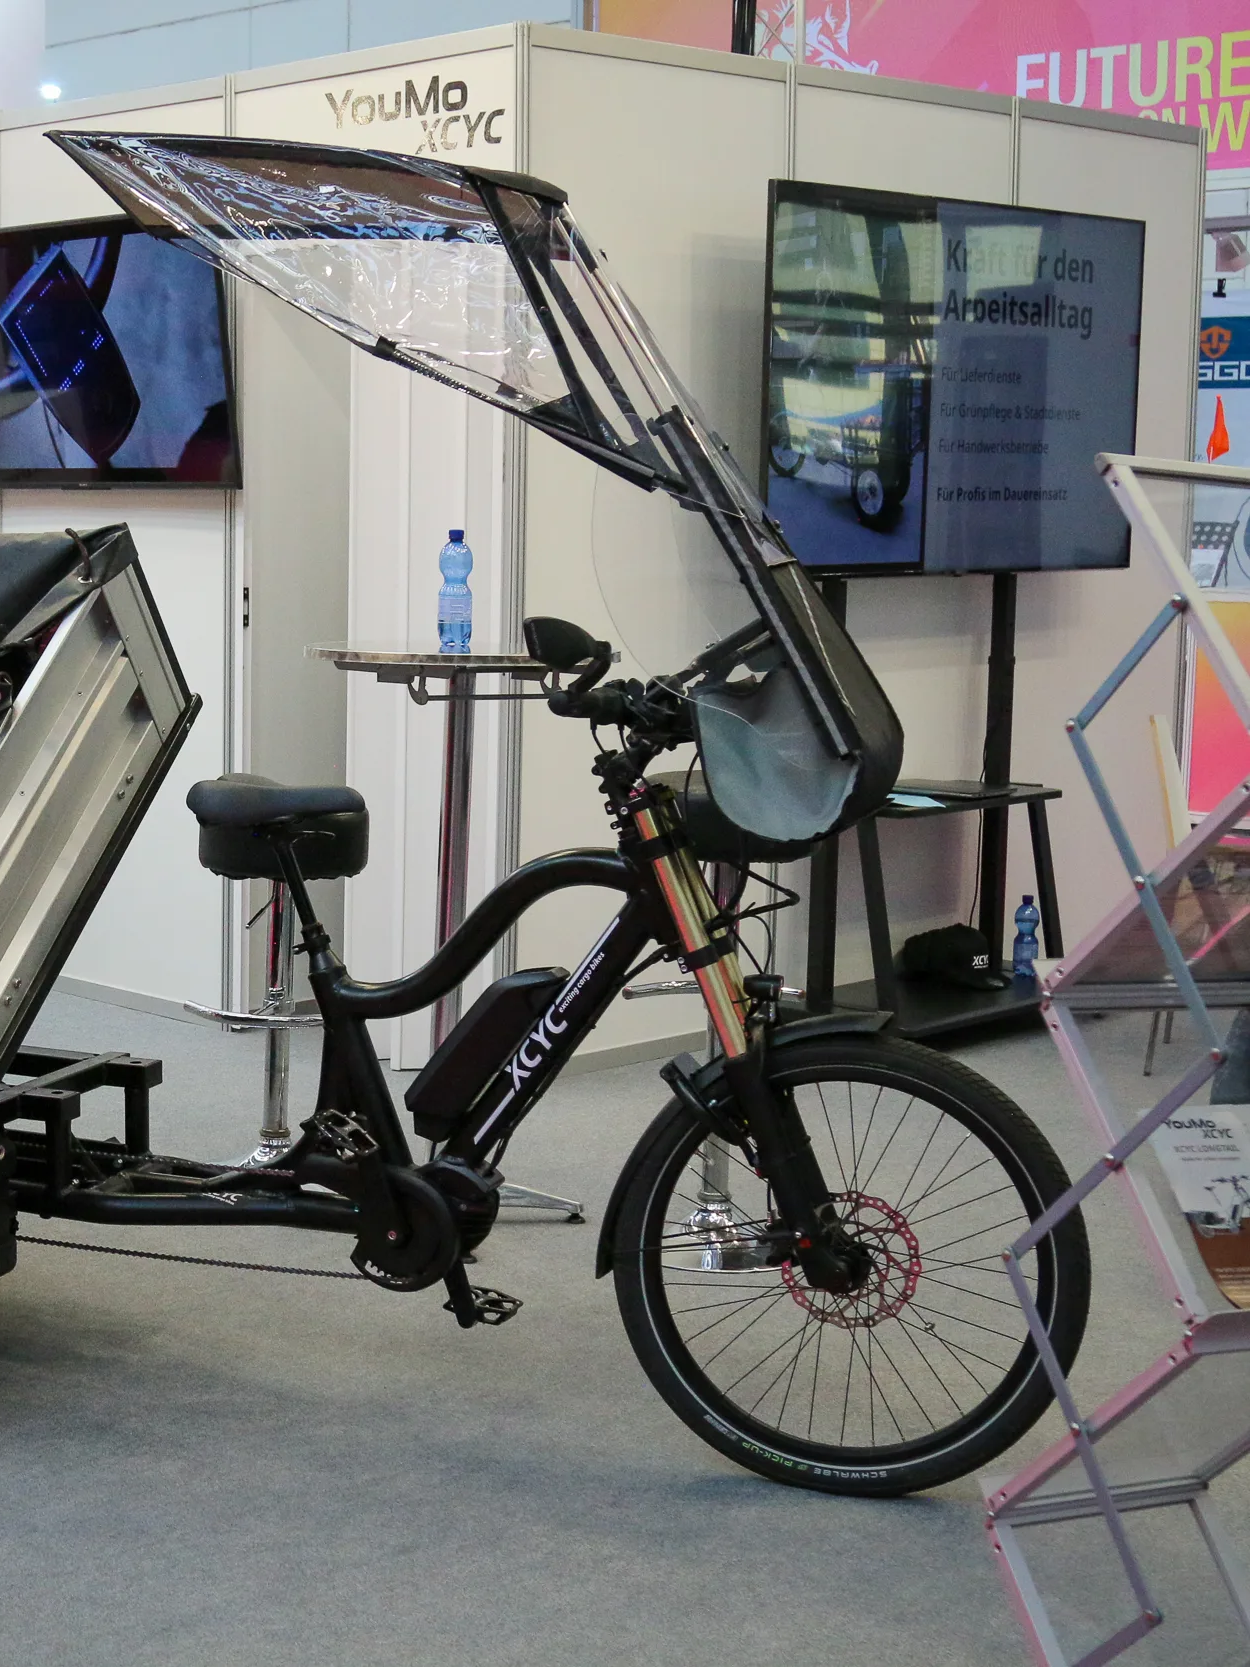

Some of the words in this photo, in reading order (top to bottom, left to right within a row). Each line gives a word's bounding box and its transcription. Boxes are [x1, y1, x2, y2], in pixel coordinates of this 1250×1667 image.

[1016, 30, 1250, 110] FUTURE
[324, 75, 468, 130] YouMo
[414, 108, 506, 155] XCYC
[1053, 248, 1094, 284] den
[943, 289, 1094, 341] Arbeitsalltag
[940, 367, 958, 382] Für
[960, 367, 1022, 385] Lieferdienste
[939, 403, 956, 417] Für
[958, 403, 1013, 422] Grünpflege
[938, 439, 954, 453] Für
[936, 487, 954, 501] Für
[956, 487, 985, 501] Profis
[988, 487, 1001, 501] im
[1003, 487, 1069, 502] Dauereinsatz
[972, 954, 989, 966] XCY
[505, 1003, 568, 1092] XCYC
[558, 987, 580, 1013] exciting
[577, 968, 592, 989] cargo
[590, 951, 605, 971] bikes
[1202, 1128, 1234, 1139] XCYC
[741, 1441, 794, 1467] PICK-UP
[813, 1467, 888, 1478] SCHWALBE
